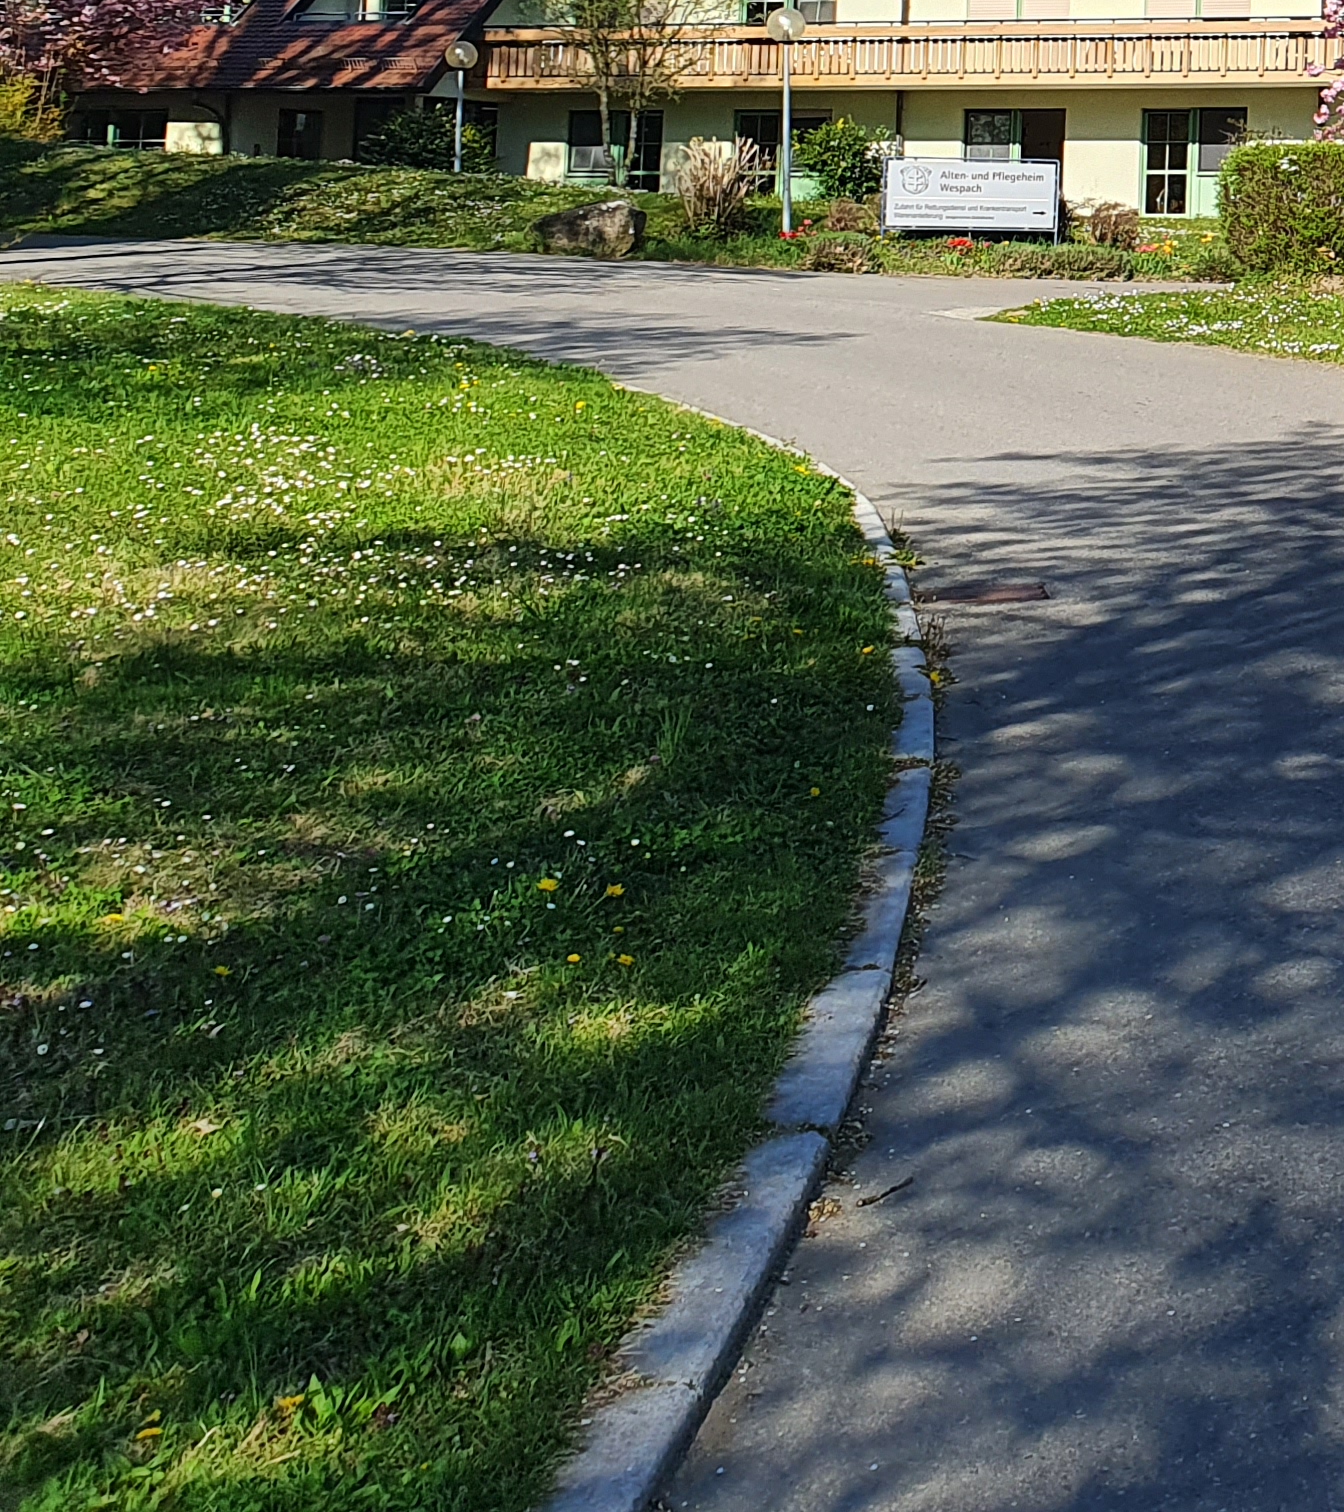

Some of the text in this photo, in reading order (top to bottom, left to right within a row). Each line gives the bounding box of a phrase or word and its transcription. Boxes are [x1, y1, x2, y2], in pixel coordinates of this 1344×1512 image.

[940, 170, 1045, 183] Alten- und Pflegeheim
[940, 183, 982, 194] Wespach
